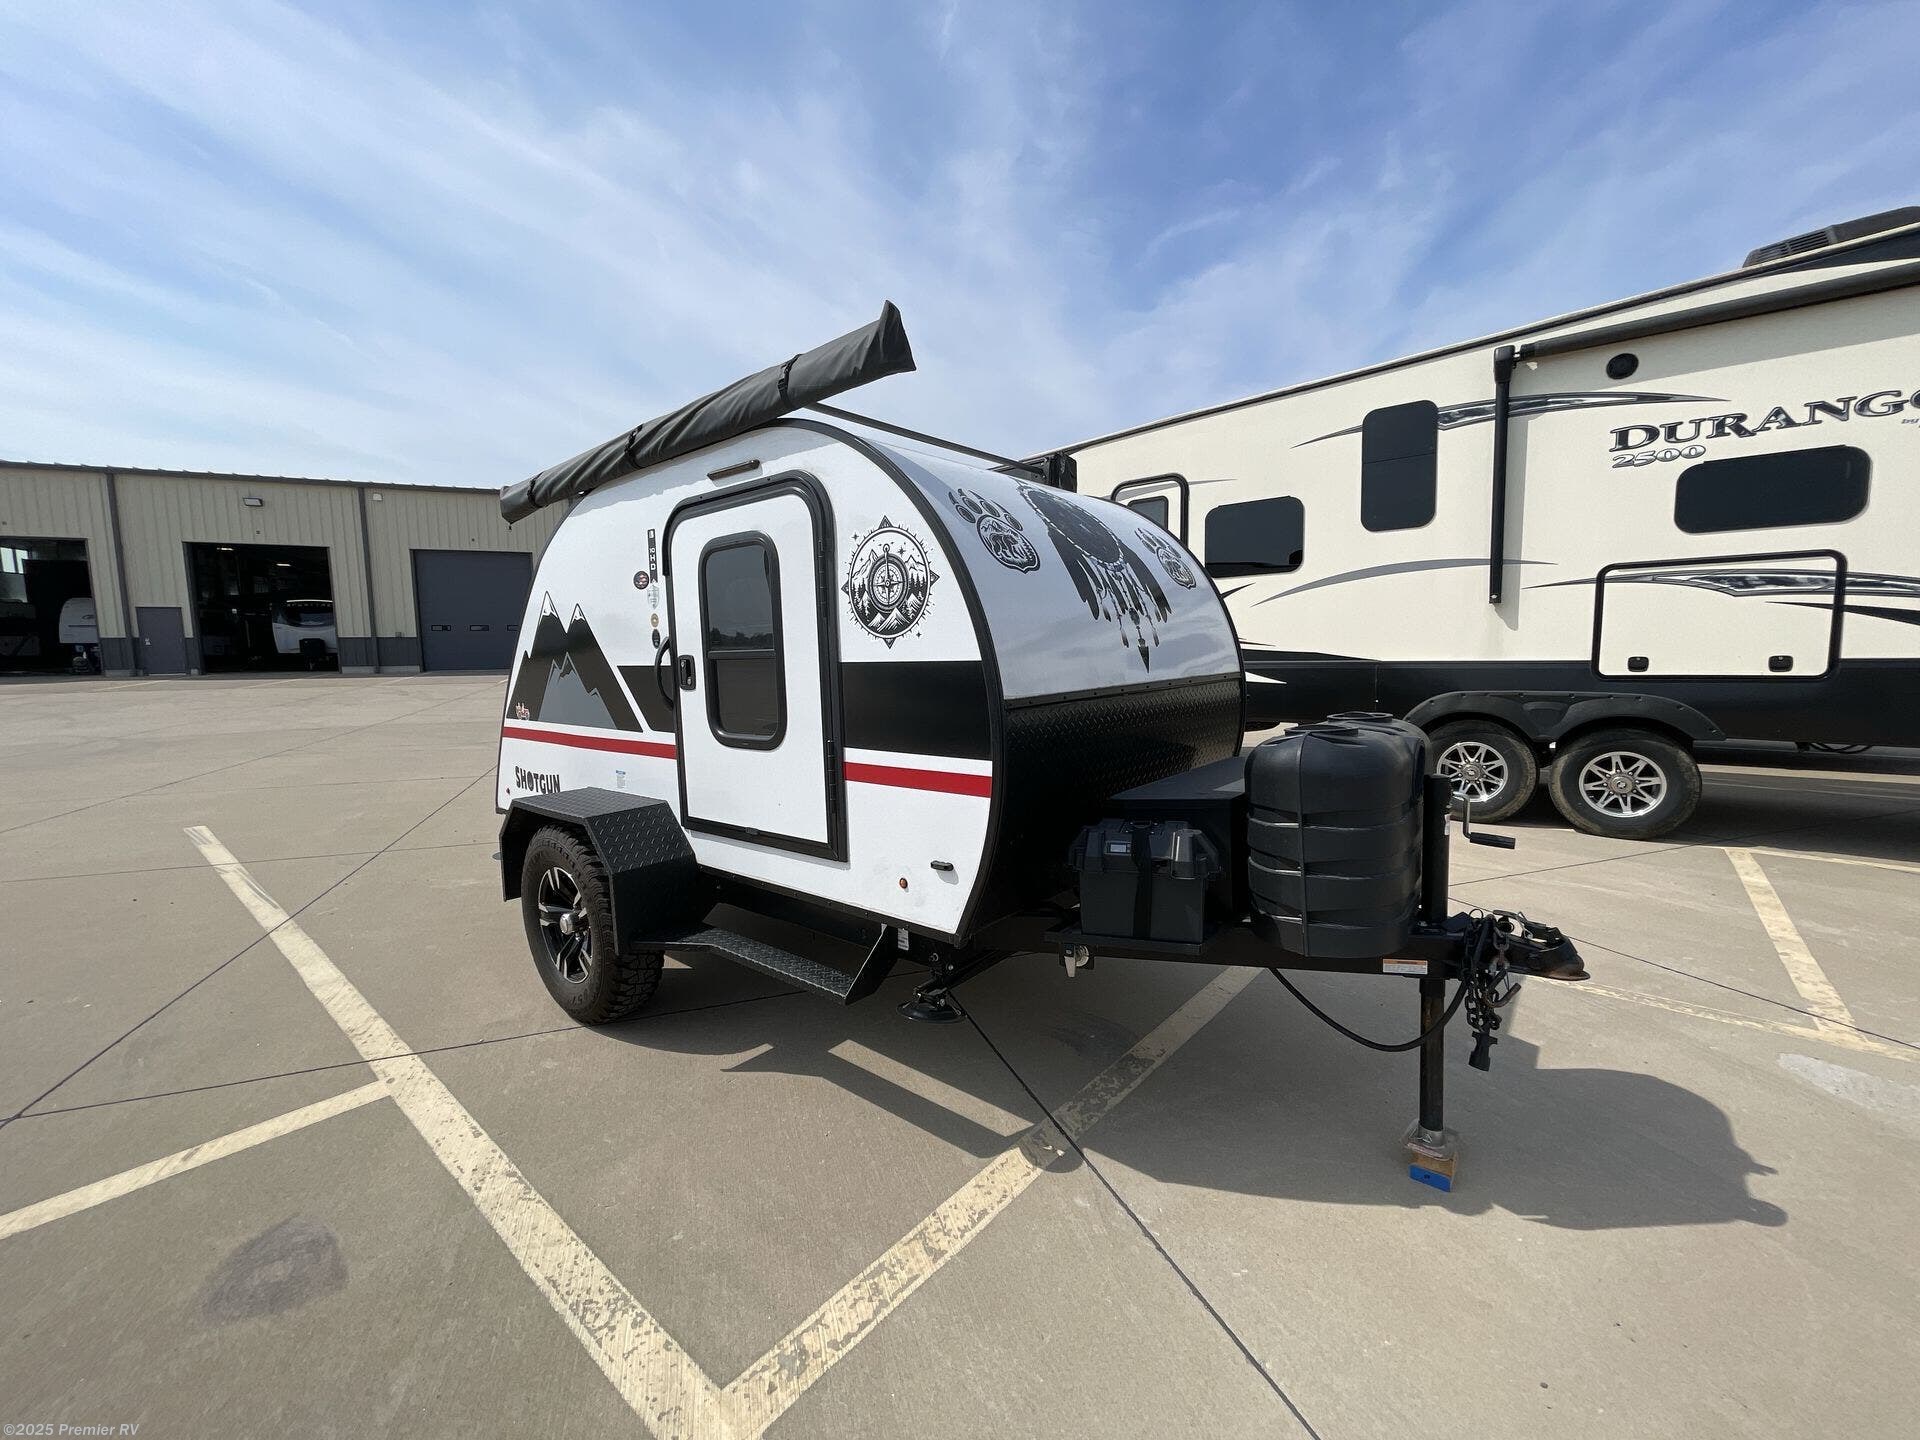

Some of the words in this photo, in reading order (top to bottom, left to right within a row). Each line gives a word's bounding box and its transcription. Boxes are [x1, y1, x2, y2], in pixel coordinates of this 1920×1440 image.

[1609, 390, 1920, 452] DURANG
[1611, 444, 1707, 469] 2500
[514, 765, 561, 795] SHOTGUN
